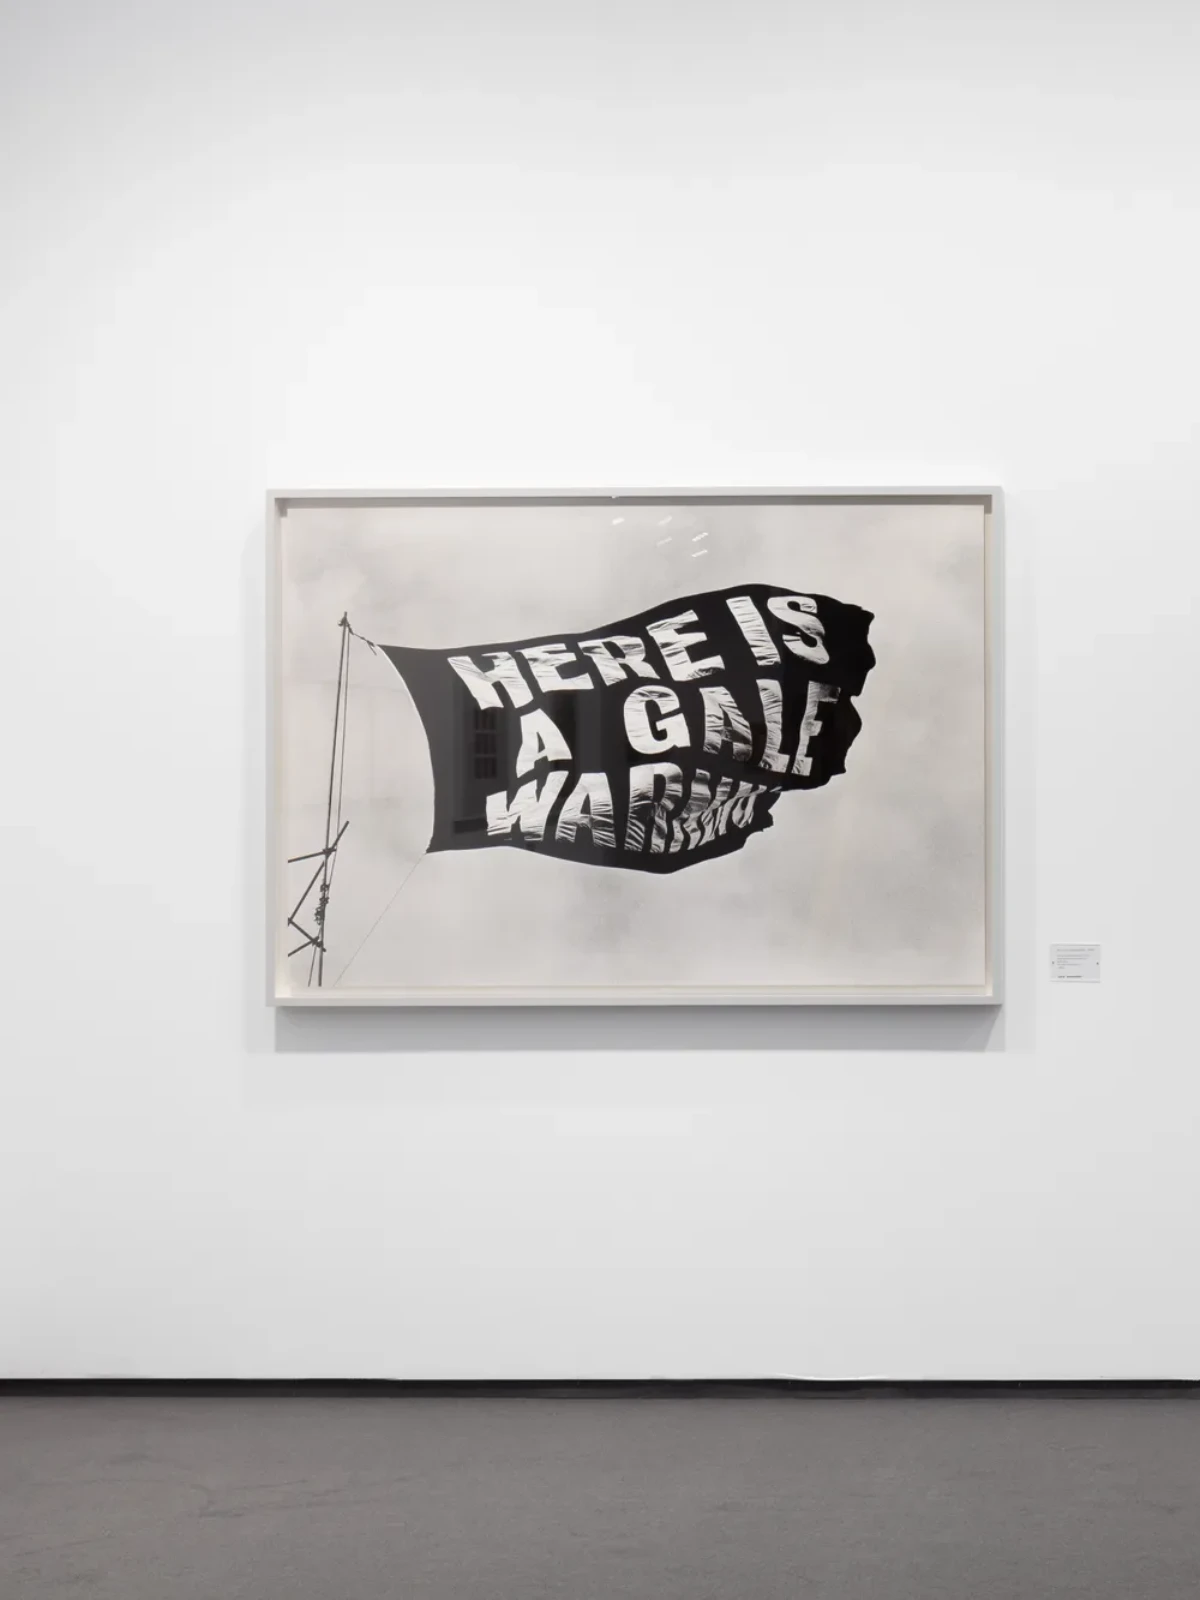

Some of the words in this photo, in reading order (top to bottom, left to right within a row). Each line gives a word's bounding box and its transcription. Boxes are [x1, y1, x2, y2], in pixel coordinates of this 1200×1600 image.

[447, 609, 726, 710] HERE
[725, 595, 831, 667] IS
[515, 707, 573, 779] A
[622, 678, 842, 777] GALE
